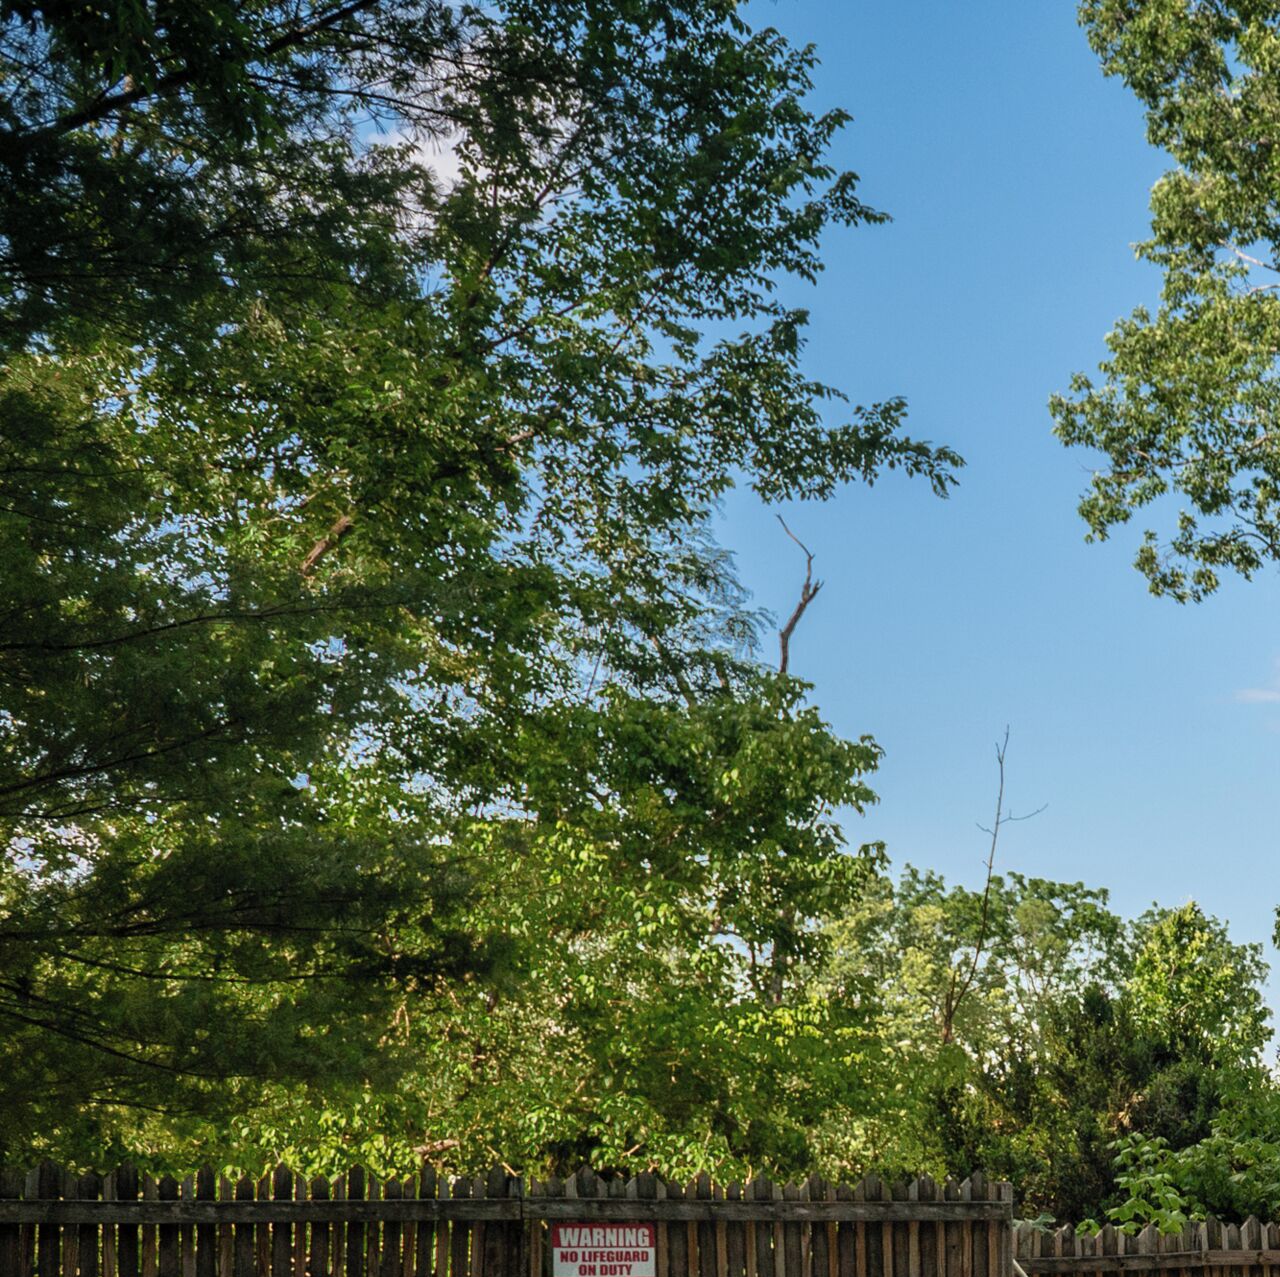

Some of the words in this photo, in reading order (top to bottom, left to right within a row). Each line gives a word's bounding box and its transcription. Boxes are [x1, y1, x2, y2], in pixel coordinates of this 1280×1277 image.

[559, 1228, 650, 1248] WARNING
[560, 1251, 578, 1263] NO
[582, 1251, 649, 1262] LIFEGUARD
[579, 1264, 596, 1276] ON
[600, 1264, 632, 1276] DUTY
